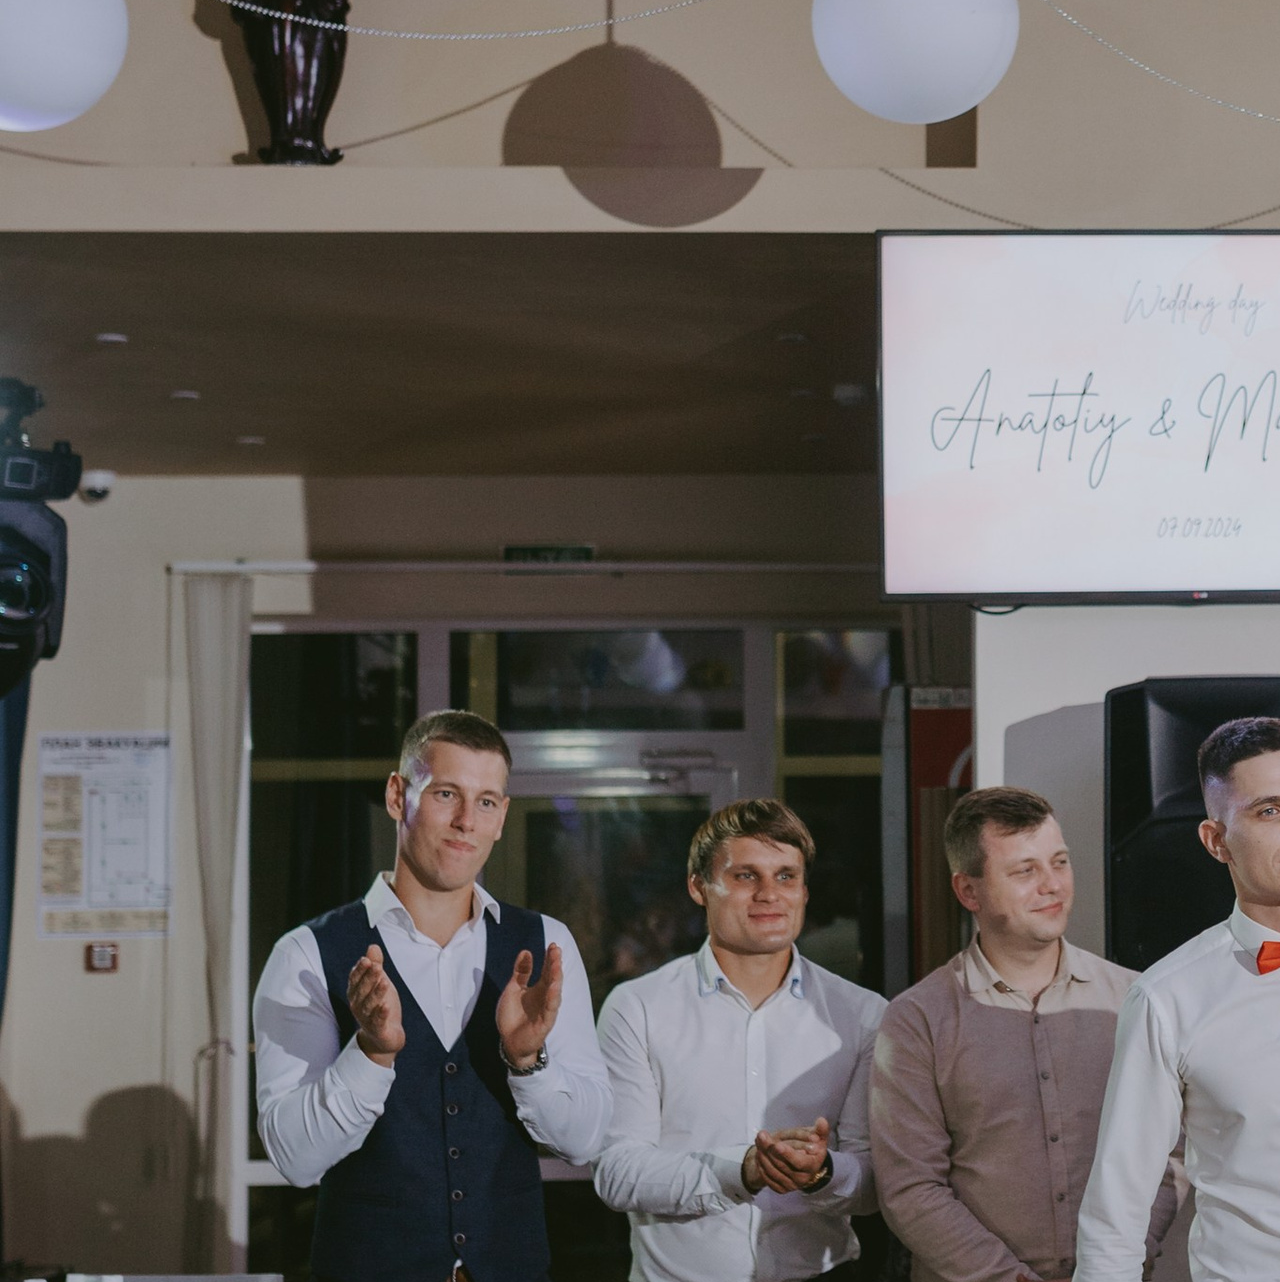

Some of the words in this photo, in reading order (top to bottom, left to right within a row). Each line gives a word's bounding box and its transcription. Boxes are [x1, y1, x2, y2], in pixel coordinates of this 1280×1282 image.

[1123, 280, 1222, 335] Wedding
[1228, 283, 1265, 337] day
[1148, 397, 1176, 439] &
